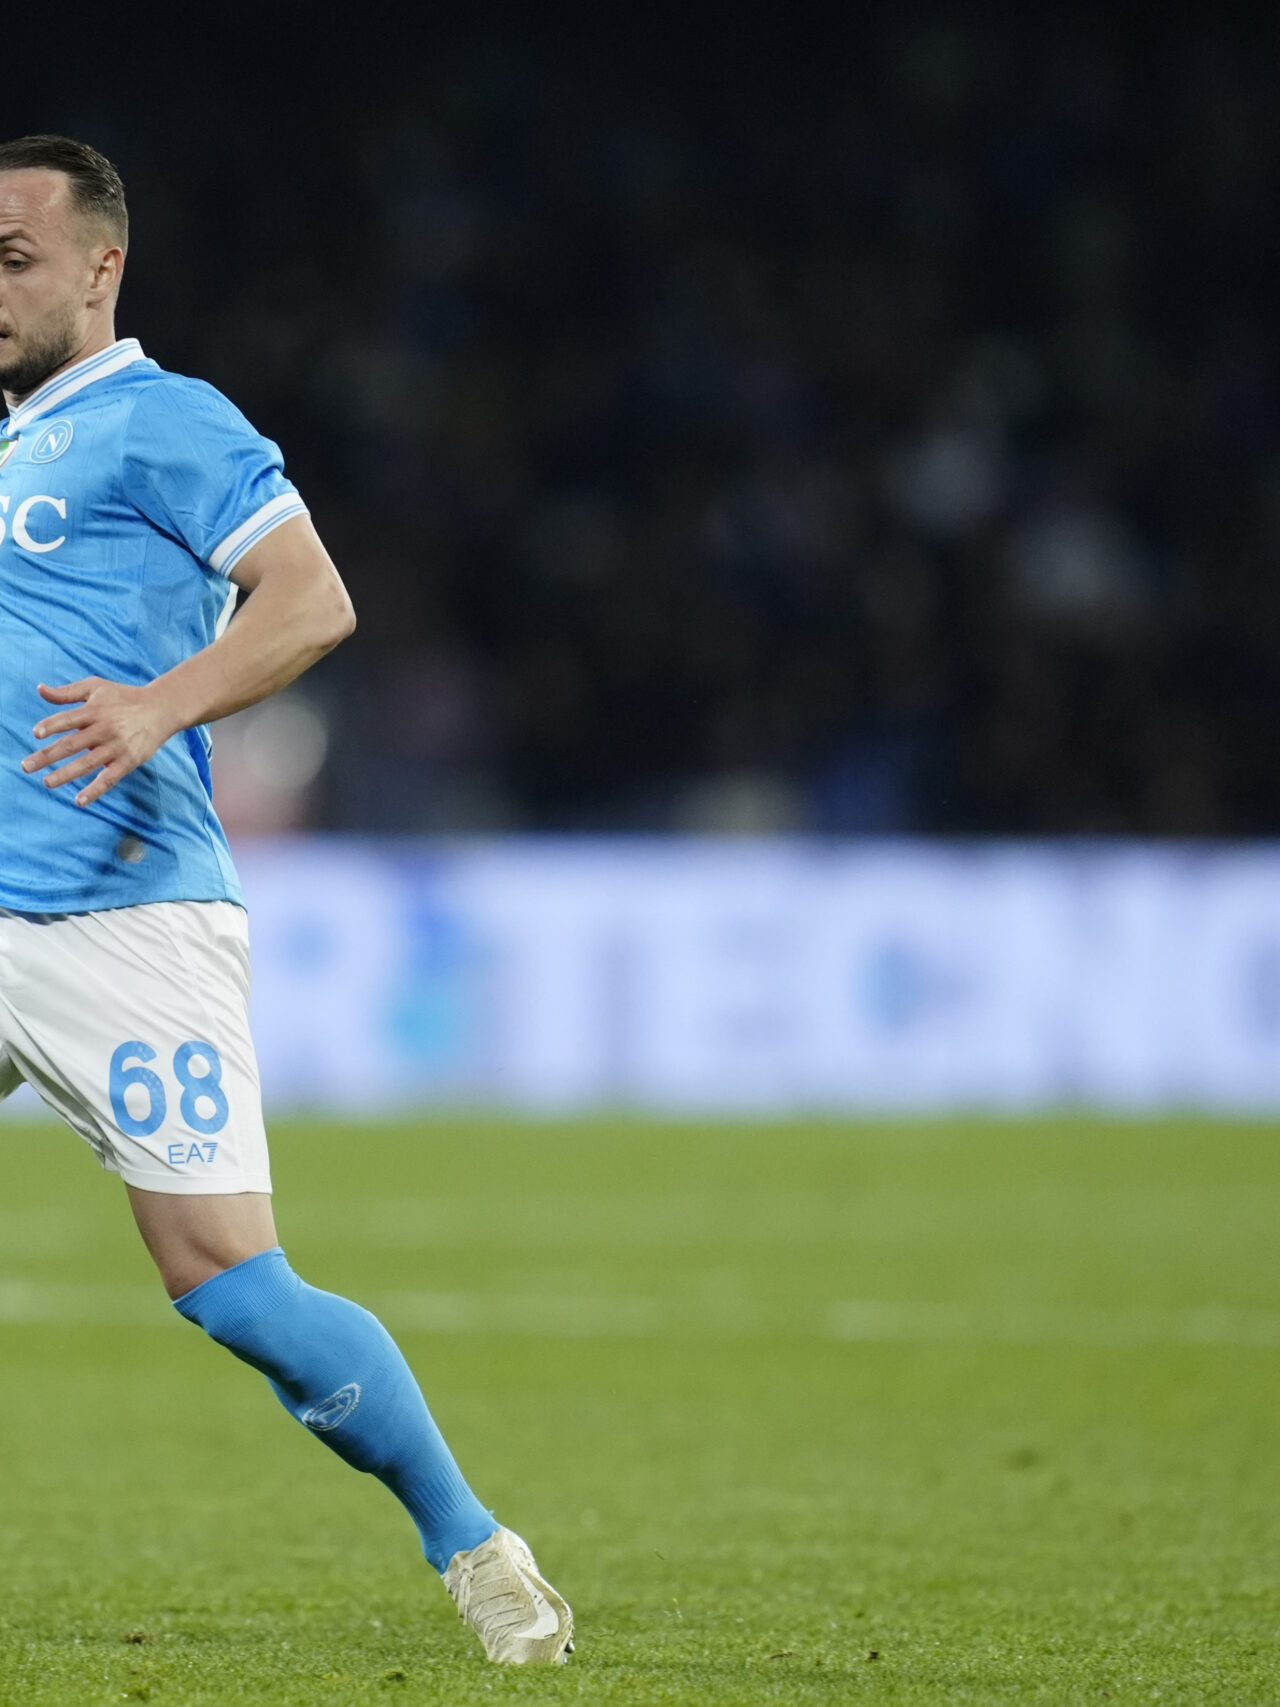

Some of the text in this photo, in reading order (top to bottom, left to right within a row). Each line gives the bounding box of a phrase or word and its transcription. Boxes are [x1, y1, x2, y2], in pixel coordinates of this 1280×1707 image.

[39, 431, 64, 454] N
[109, 1040, 229, 1137] 68
[167, 1142, 218, 1164] EA7
